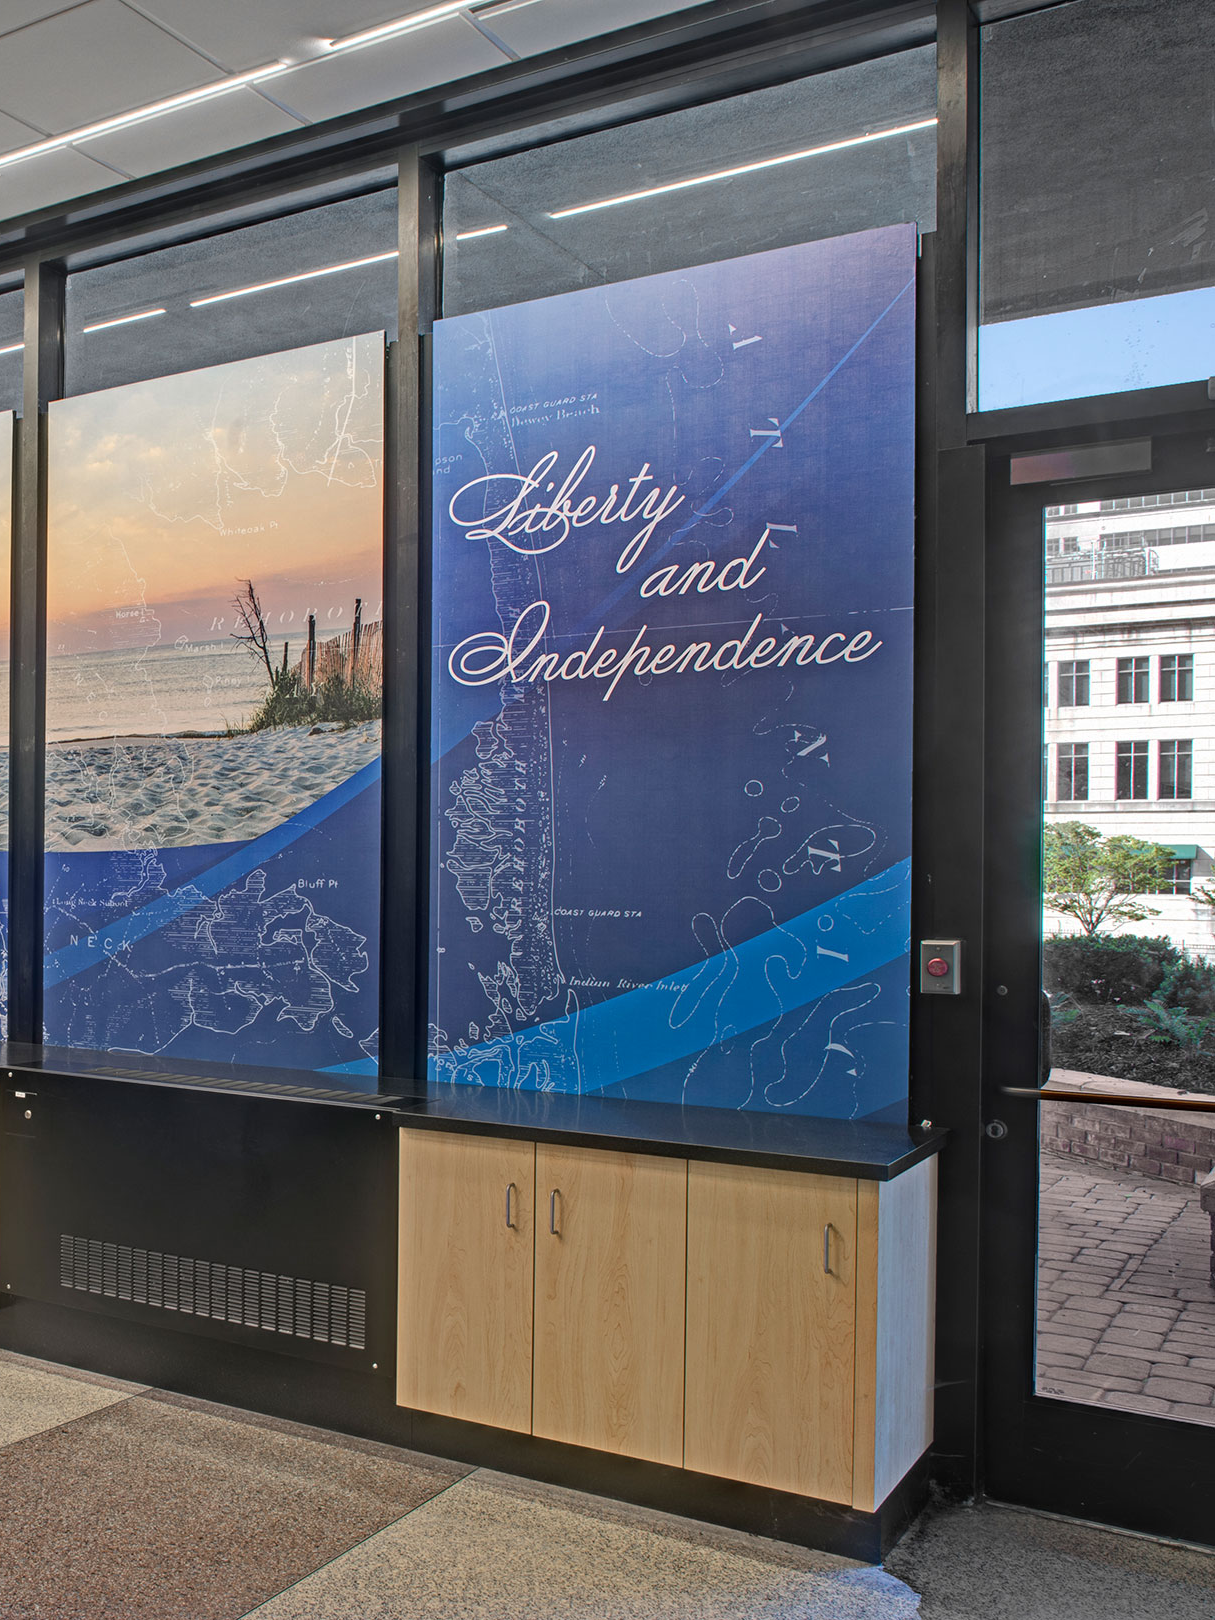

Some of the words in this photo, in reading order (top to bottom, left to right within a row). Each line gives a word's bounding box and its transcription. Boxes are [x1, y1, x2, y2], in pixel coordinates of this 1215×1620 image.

[543, 396, 576, 409] GUARD
[579, 392, 598, 402] STA
[449, 445, 686, 573] Liberty
[640, 528, 770, 598] and
[448, 600, 883, 701] Independence
[298, 878, 325, 889] Bluff
[328, 879, 339, 889] Pt
[554, 907, 585, 916] COAST
[588, 908, 621, 918] GUARD
[623, 909, 643, 918] STA
[70, 934, 132, 953] NECK
[569, 976, 610, 988] Indian
[617, 978, 653, 989] River
